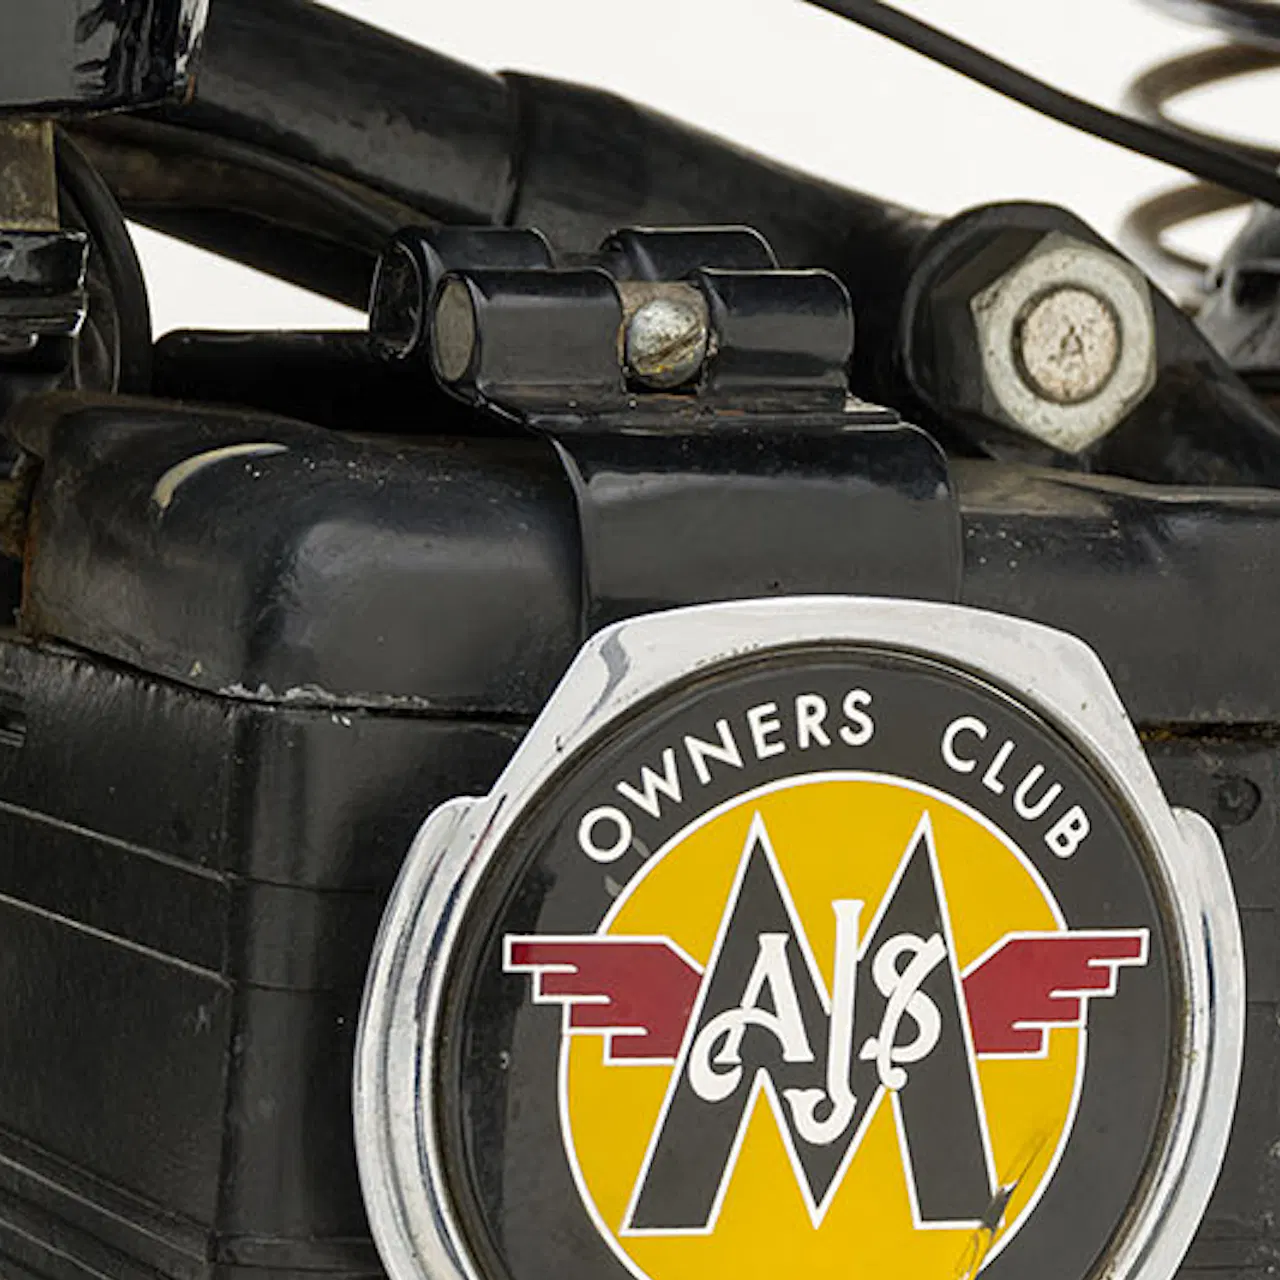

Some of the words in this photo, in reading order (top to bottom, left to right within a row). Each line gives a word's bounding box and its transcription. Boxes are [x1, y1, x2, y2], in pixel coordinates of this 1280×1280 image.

[578, 689, 874, 863] OWNERS
[941, 716, 1091, 859] CLUB
[688, 898, 947, 1146] AJS
